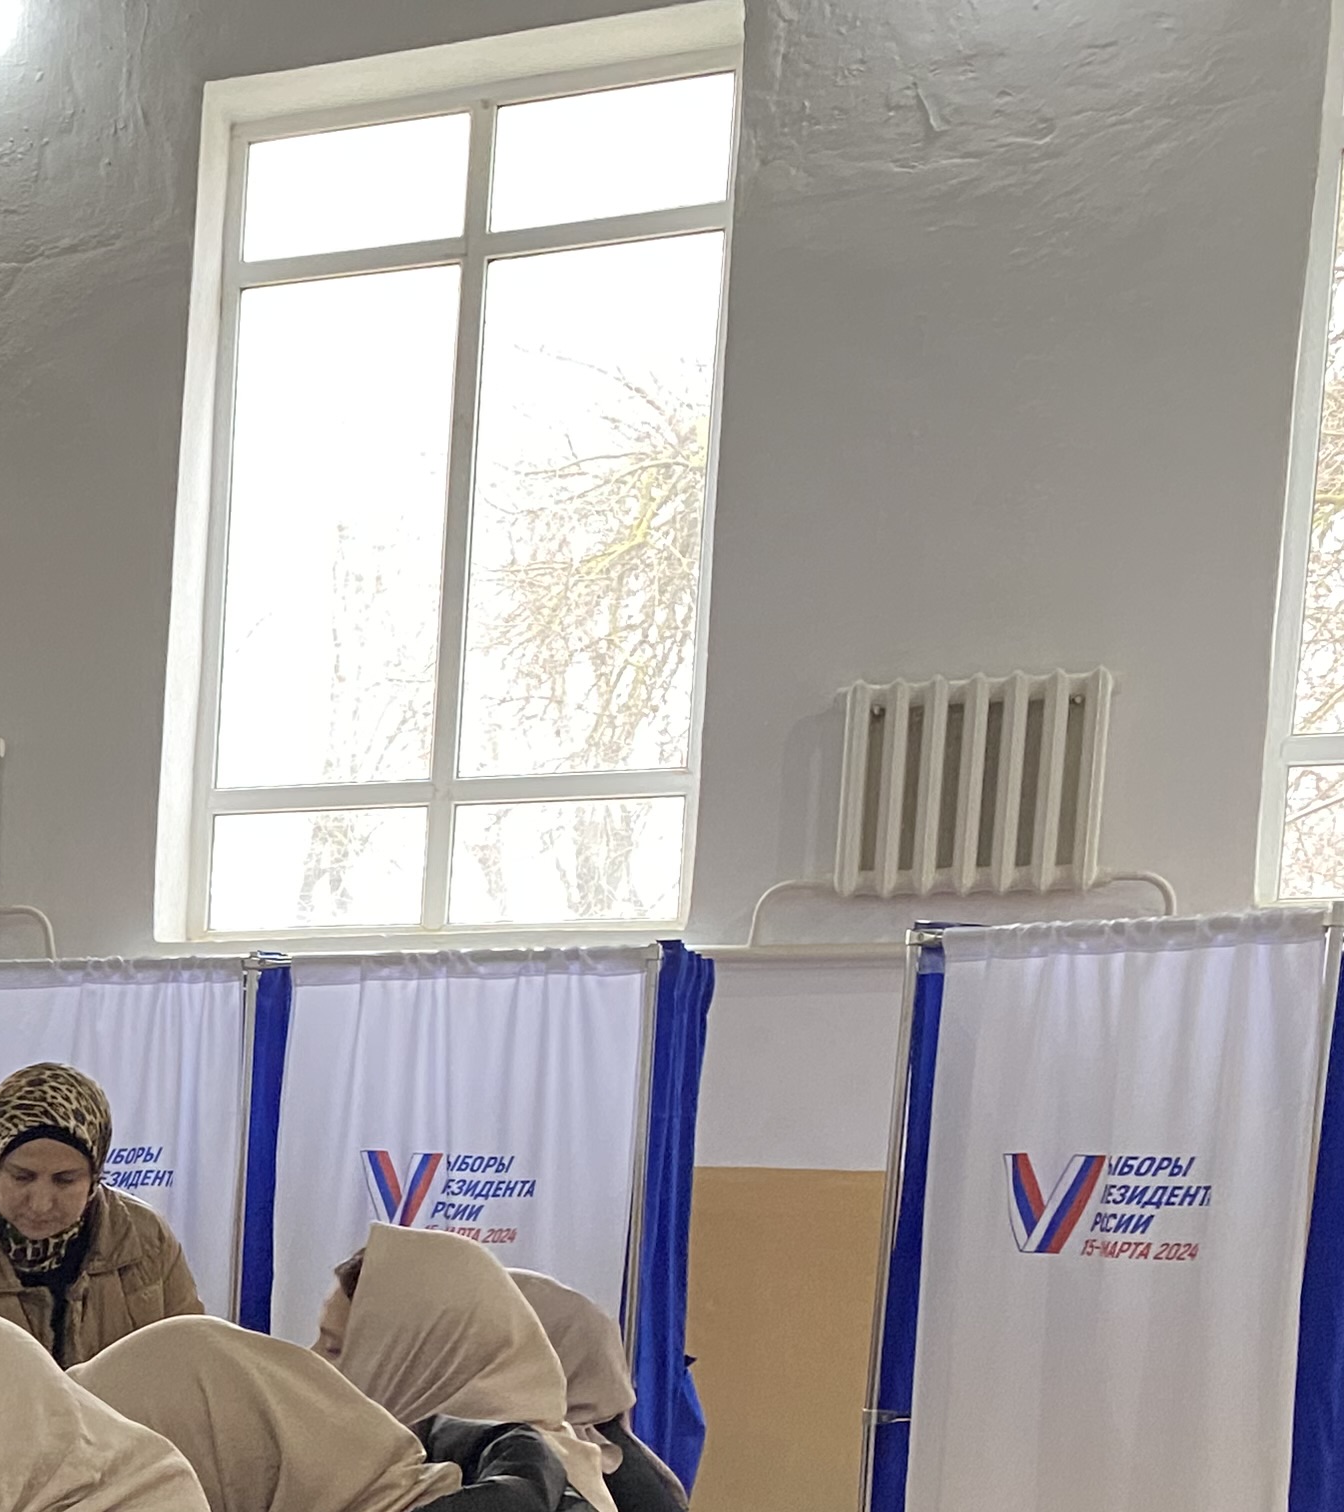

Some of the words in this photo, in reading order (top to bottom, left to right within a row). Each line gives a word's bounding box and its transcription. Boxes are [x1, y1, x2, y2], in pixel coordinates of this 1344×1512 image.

[106, 1146, 163, 1164] БОРЫ
[447, 1154, 515, 1174] ЫБОРЫ
[1108, 1156, 1196, 1177] ЫБОРЫ
[441, 1179, 537, 1200] ЕЗИДЕНТА
[481, 1228, 518, 1244] 2024
[1153, 1243, 1200, 1260] 2024
